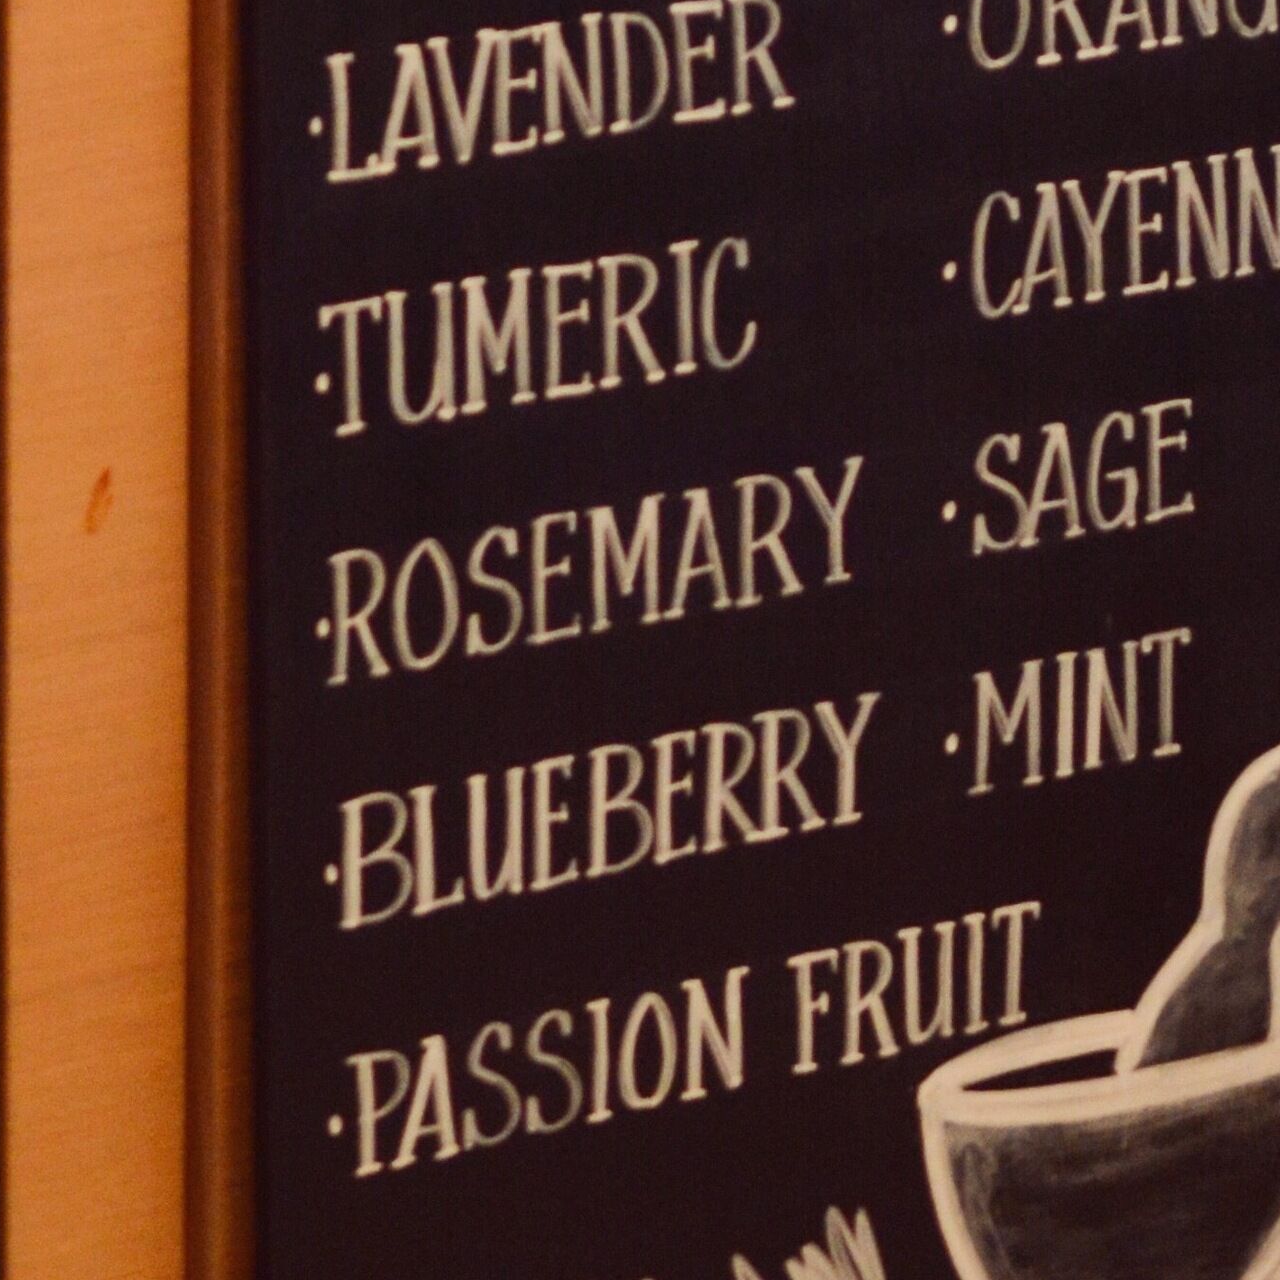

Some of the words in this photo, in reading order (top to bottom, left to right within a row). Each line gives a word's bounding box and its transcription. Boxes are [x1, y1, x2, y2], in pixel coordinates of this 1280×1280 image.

[318, 236, 758, 438] TUMERIC
[326, 454, 865, 687] ROSEMARY
[971, 396, 1196, 557] SAGE
[339, 691, 882, 931] BLUEBERRY
[967, 626, 1193, 796] MINT
[345, 964, 751, 1178] PASSION
[785, 899, 1042, 1076] FRUIT
